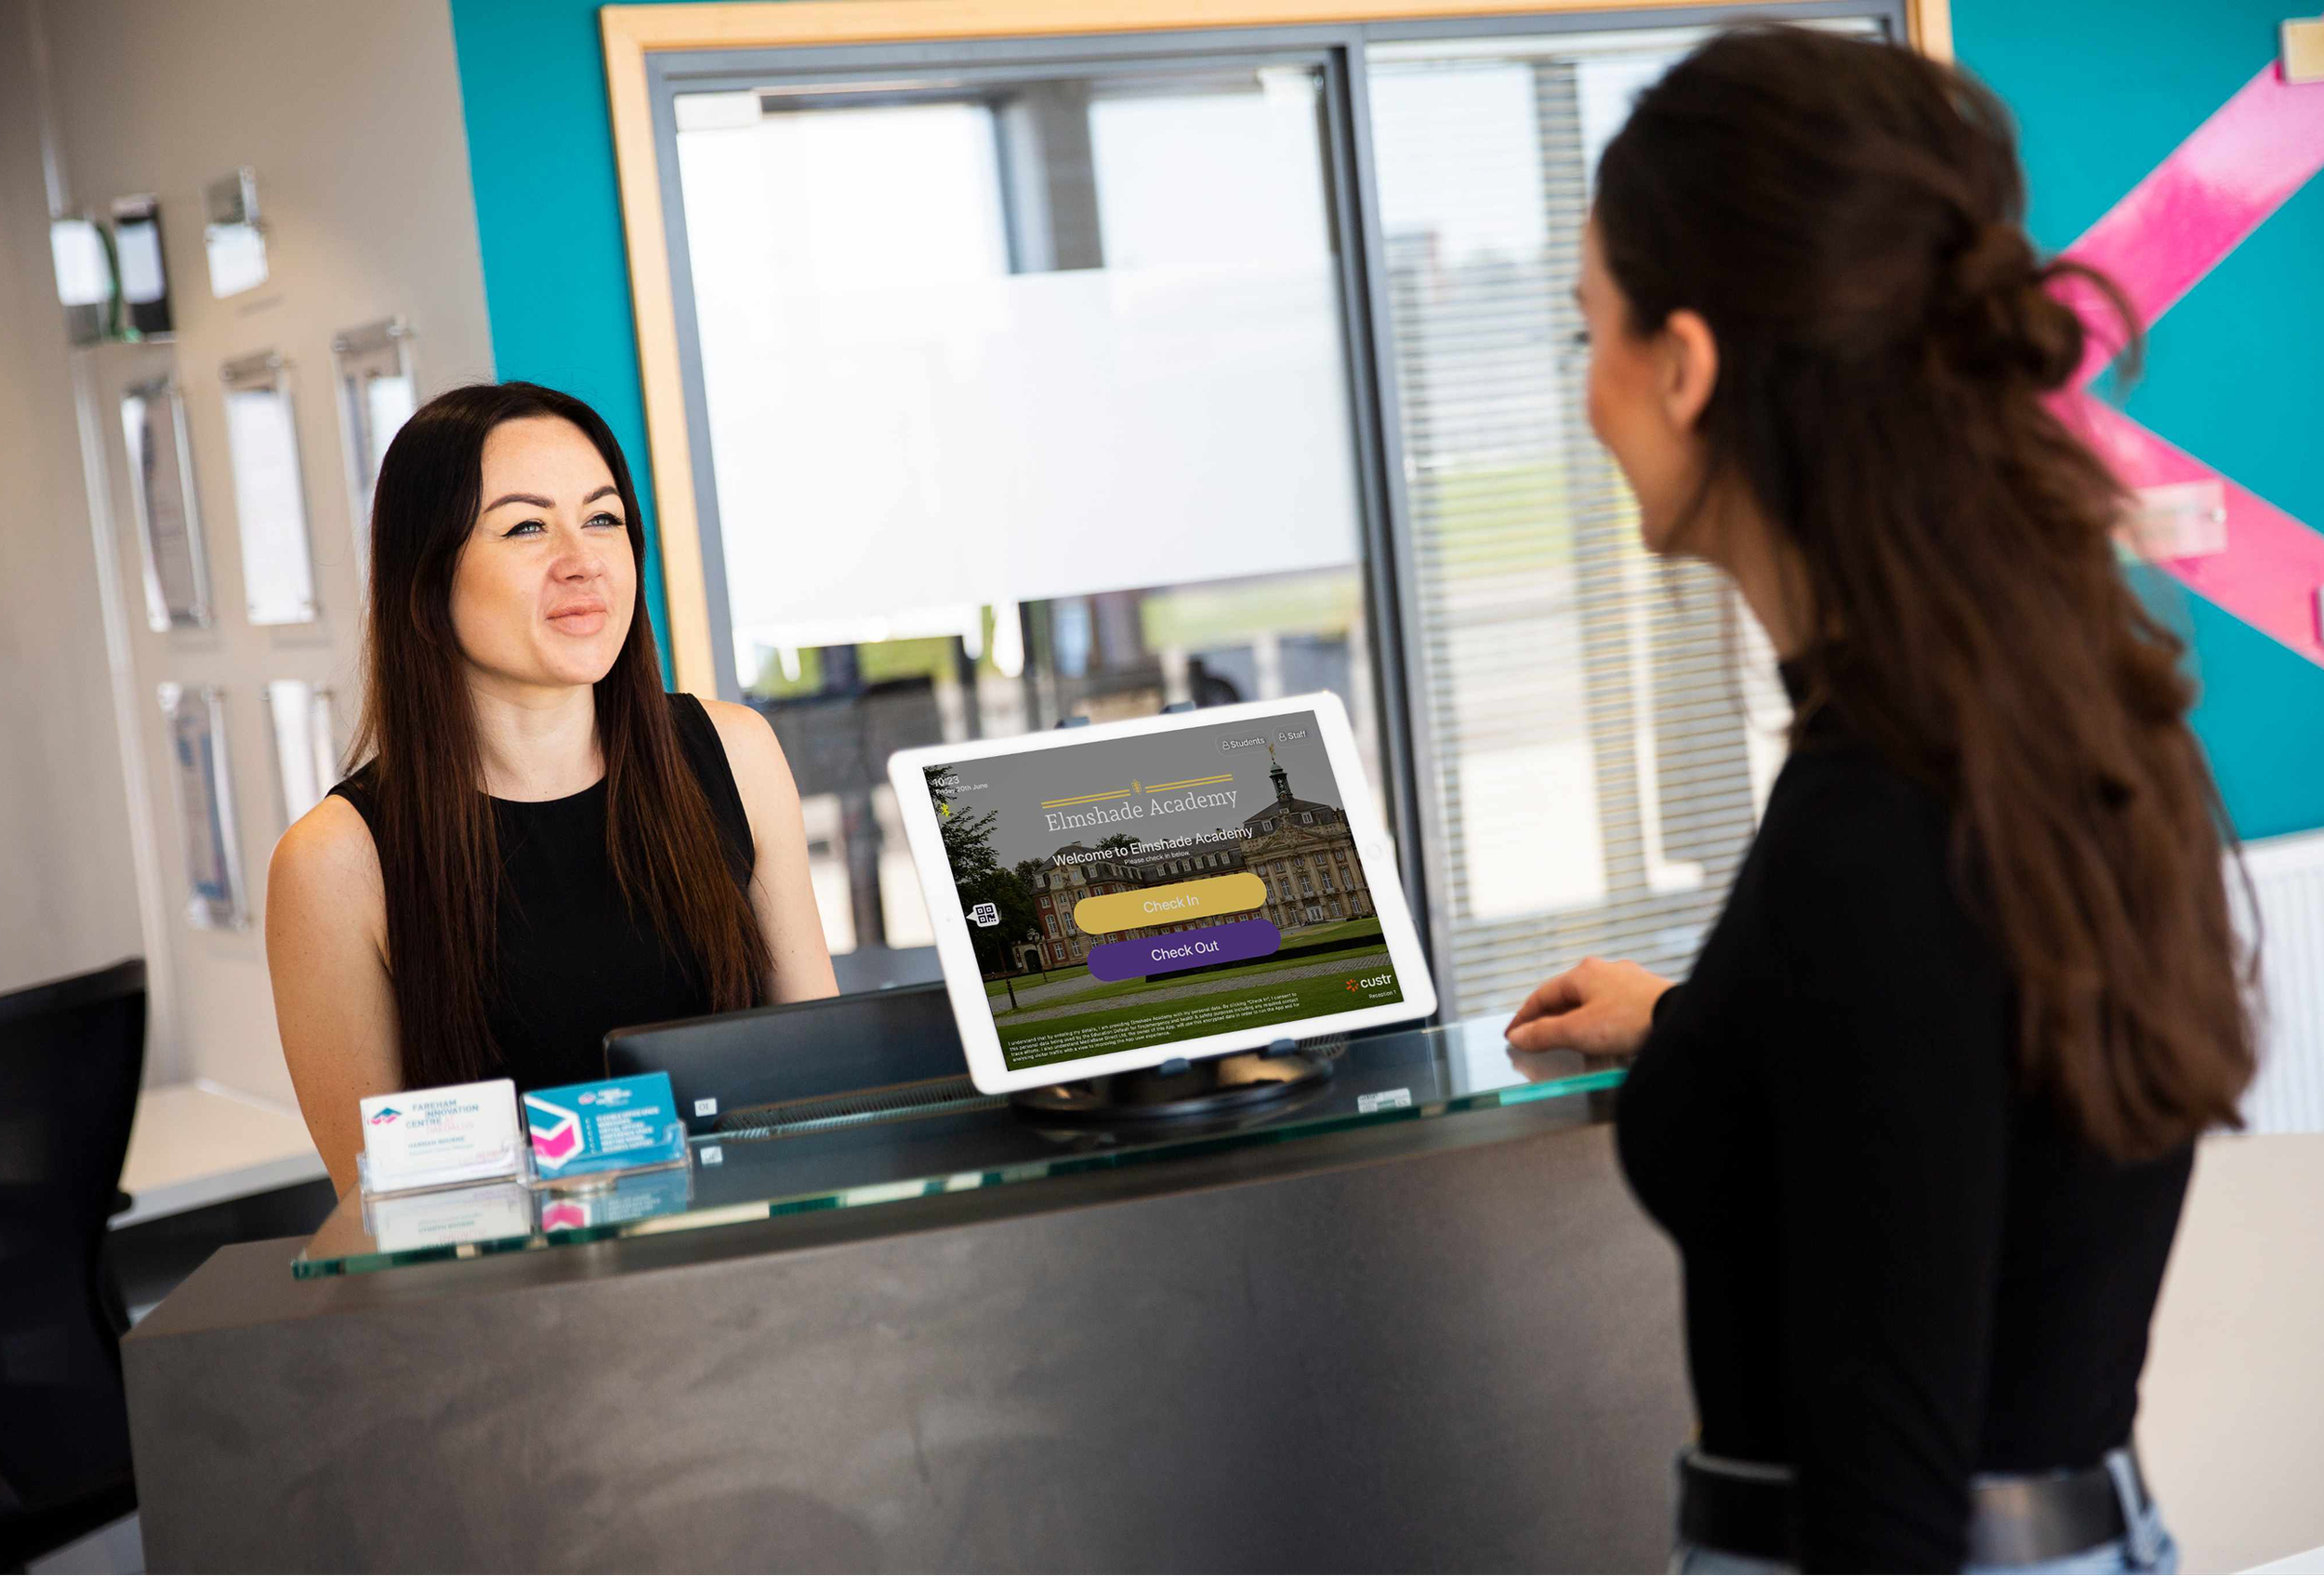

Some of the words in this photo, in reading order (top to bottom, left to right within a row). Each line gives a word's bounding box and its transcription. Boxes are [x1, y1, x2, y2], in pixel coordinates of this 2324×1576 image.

[1287, 731, 1306, 739] Staff
[1230, 737, 1265, 748] Students
[932, 775, 959, 787] 10:23
[1045, 802, 1144, 831] Elmshade
[1147, 790, 1240, 815] Academy
[1053, 850, 1113, 867] Welcome
[1115, 846, 1129, 856] to
[1130, 836, 1193, 854] Elmshade
[1195, 828, 1254, 844] Academy
[1142, 896, 1184, 913] Check
[1186, 895, 1199, 906] In
[1151, 944, 1193, 961] Check
[1195, 940, 1219, 954] Out
[1360, 974, 1393, 987] custr
[412, 1099, 456, 1111] FAREHAM
[425, 1105, 479, 1119] INNOVATION
[405, 1118, 442, 1129] CENTRE
